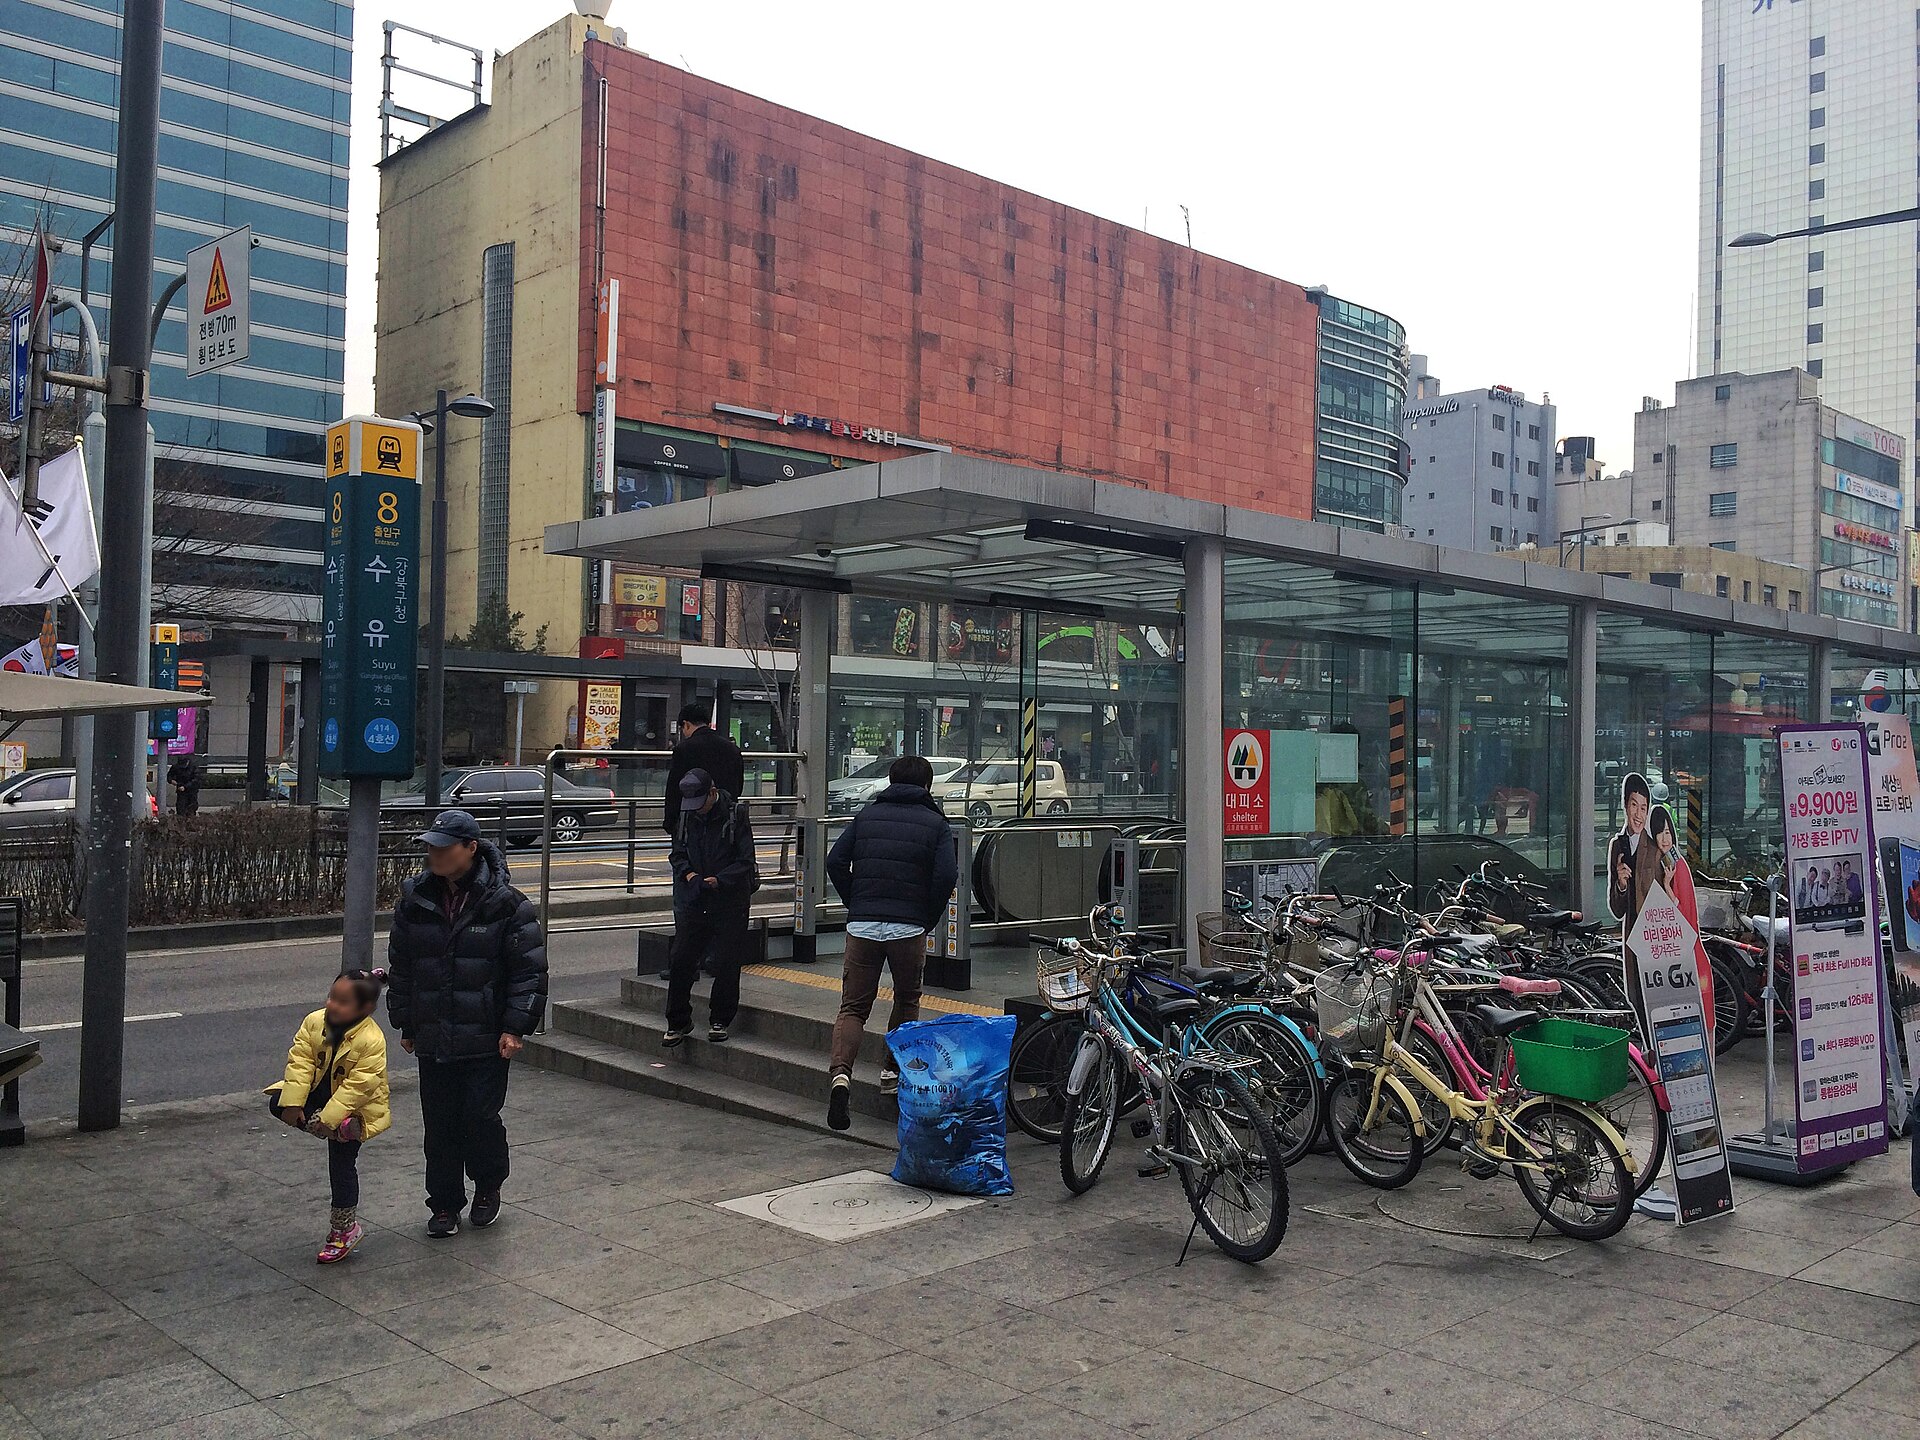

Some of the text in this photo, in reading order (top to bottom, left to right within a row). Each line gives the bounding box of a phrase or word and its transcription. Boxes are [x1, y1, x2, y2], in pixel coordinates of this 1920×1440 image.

[198, 338, 235, 365] 횡단보도
[793, 413, 898, 446] 강북볼링센터
[1874, 431, 1902, 459] YOGA
[332, 491, 342, 524] 8
[377, 491, 399, 524] 8
[374, 525, 400, 539] 출입구
[393, 557, 409, 624] (강북구청)
[362, 554, 391, 648] 수유
[642, 608, 657, 619] 1+1
[164, 647, 170, 657] 1
[372, 659, 397, 671] Suyu
[373, 724, 390, 732] 414
[367, 733, 395, 745] 4호선
[1883, 730, 1907, 749] Pro2
[1881, 774, 1902, 793] 세상의
[1225, 793, 1264, 808] 대피소
[1797, 790, 1858, 817] 9,900원
[1898, 794, 1913, 813] 되다
[1232, 811, 1258, 822] shelter
[1811, 818, 1823, 827] 으로
[1791, 828, 1859, 848] 가장 좋은 IPTV
[1645, 906, 1676, 922] 애인처럼
[1643, 925, 1683, 942] 미리 알아서
[1812, 962, 1825, 973] 국내
[1825, 960, 1837, 972] 최초
[1837, 959, 1850, 970] Full
[1851, 957, 1861, 969] HD
[1644, 970, 1664, 989] LG
[1859, 1034, 1875, 1045] VOD
[1820, 1081, 1858, 1101] 통합음성검색
